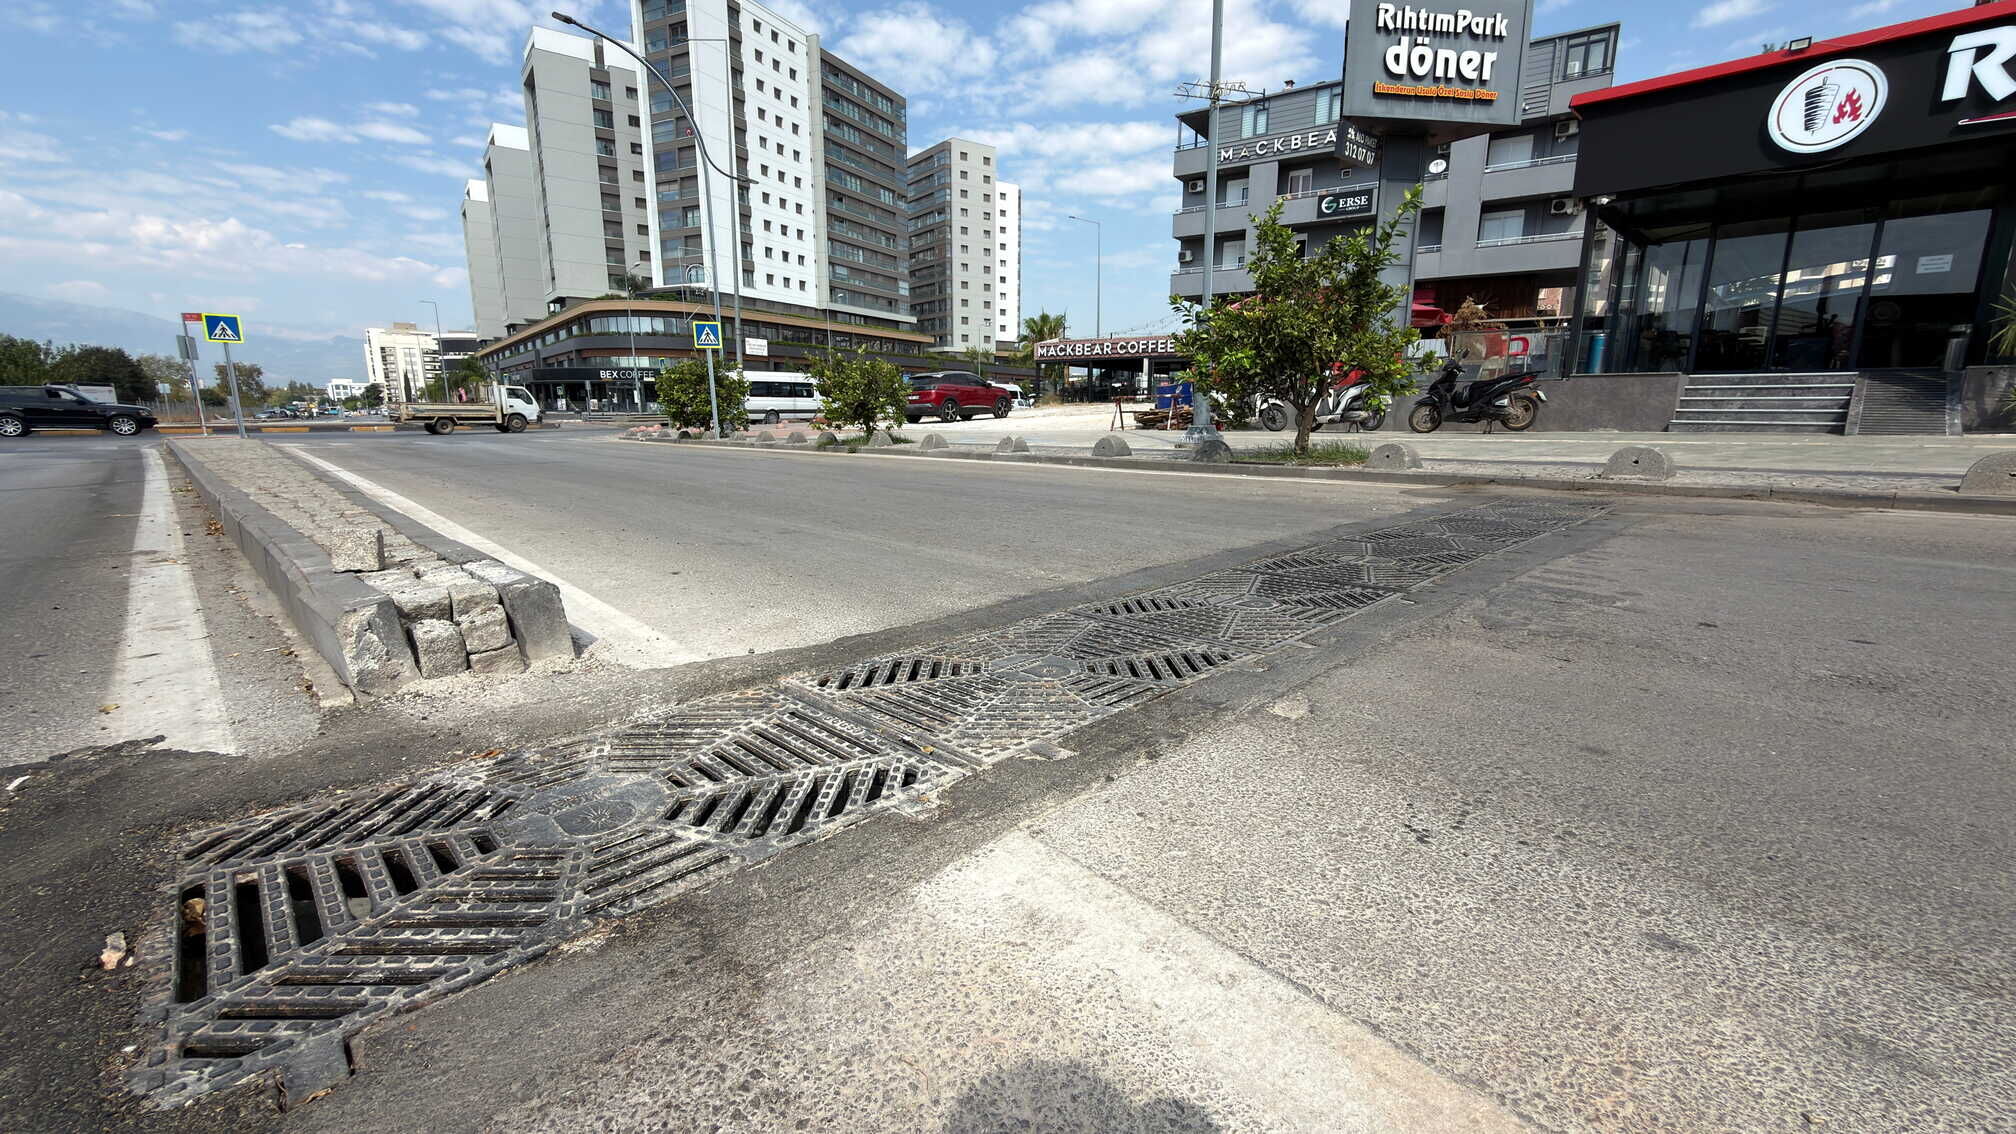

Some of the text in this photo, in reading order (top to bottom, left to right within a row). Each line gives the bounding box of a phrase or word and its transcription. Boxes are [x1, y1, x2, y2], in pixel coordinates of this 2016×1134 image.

[1385, 36, 1498, 81] döner
[1220, 129, 1337, 162] MACKBEA
[1344, 141, 1357, 159] 312
[1038, 339, 1176, 357] MACKBEAR COFFEE
[600, 370, 619, 379] BEX
